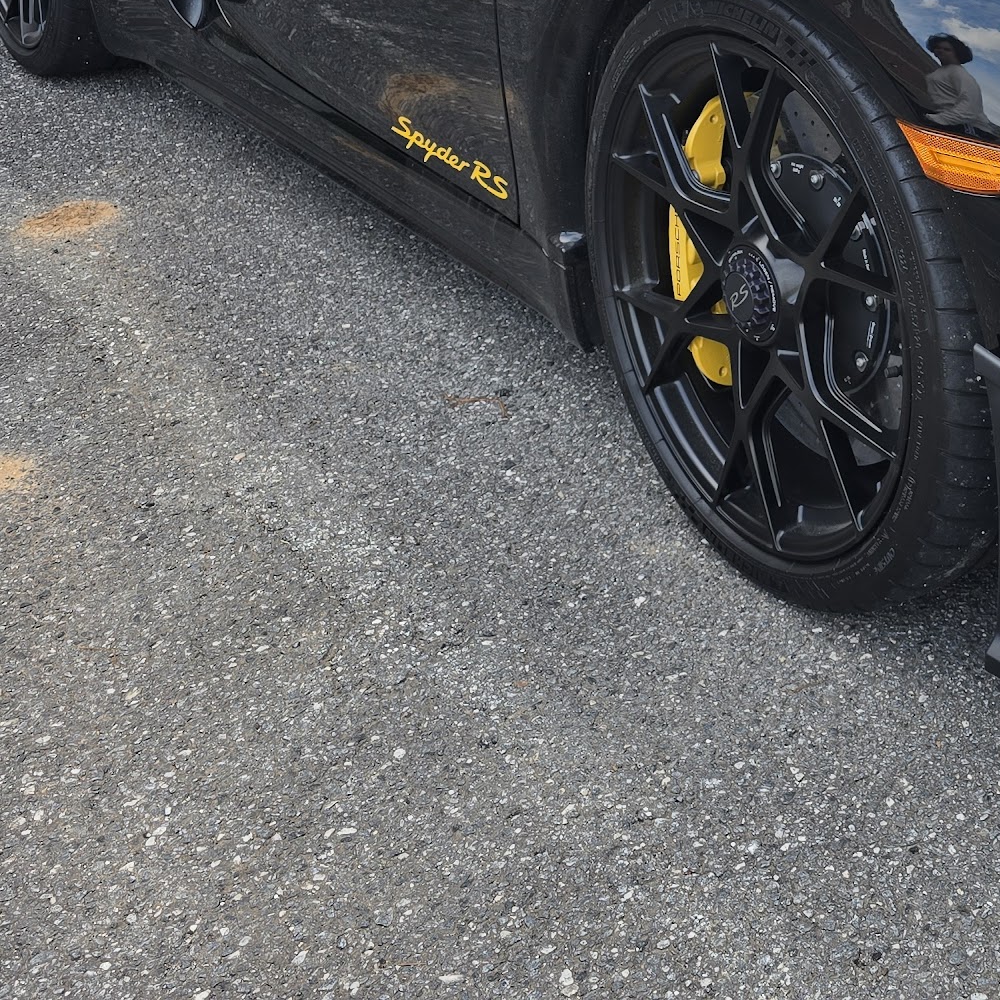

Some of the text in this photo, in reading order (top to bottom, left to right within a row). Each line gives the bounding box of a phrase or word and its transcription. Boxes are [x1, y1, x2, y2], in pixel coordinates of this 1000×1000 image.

[391, 116, 508, 199] Spyder RS
[674, 209, 682, 296] PORSCH
[729, 283, 749, 311] RS
